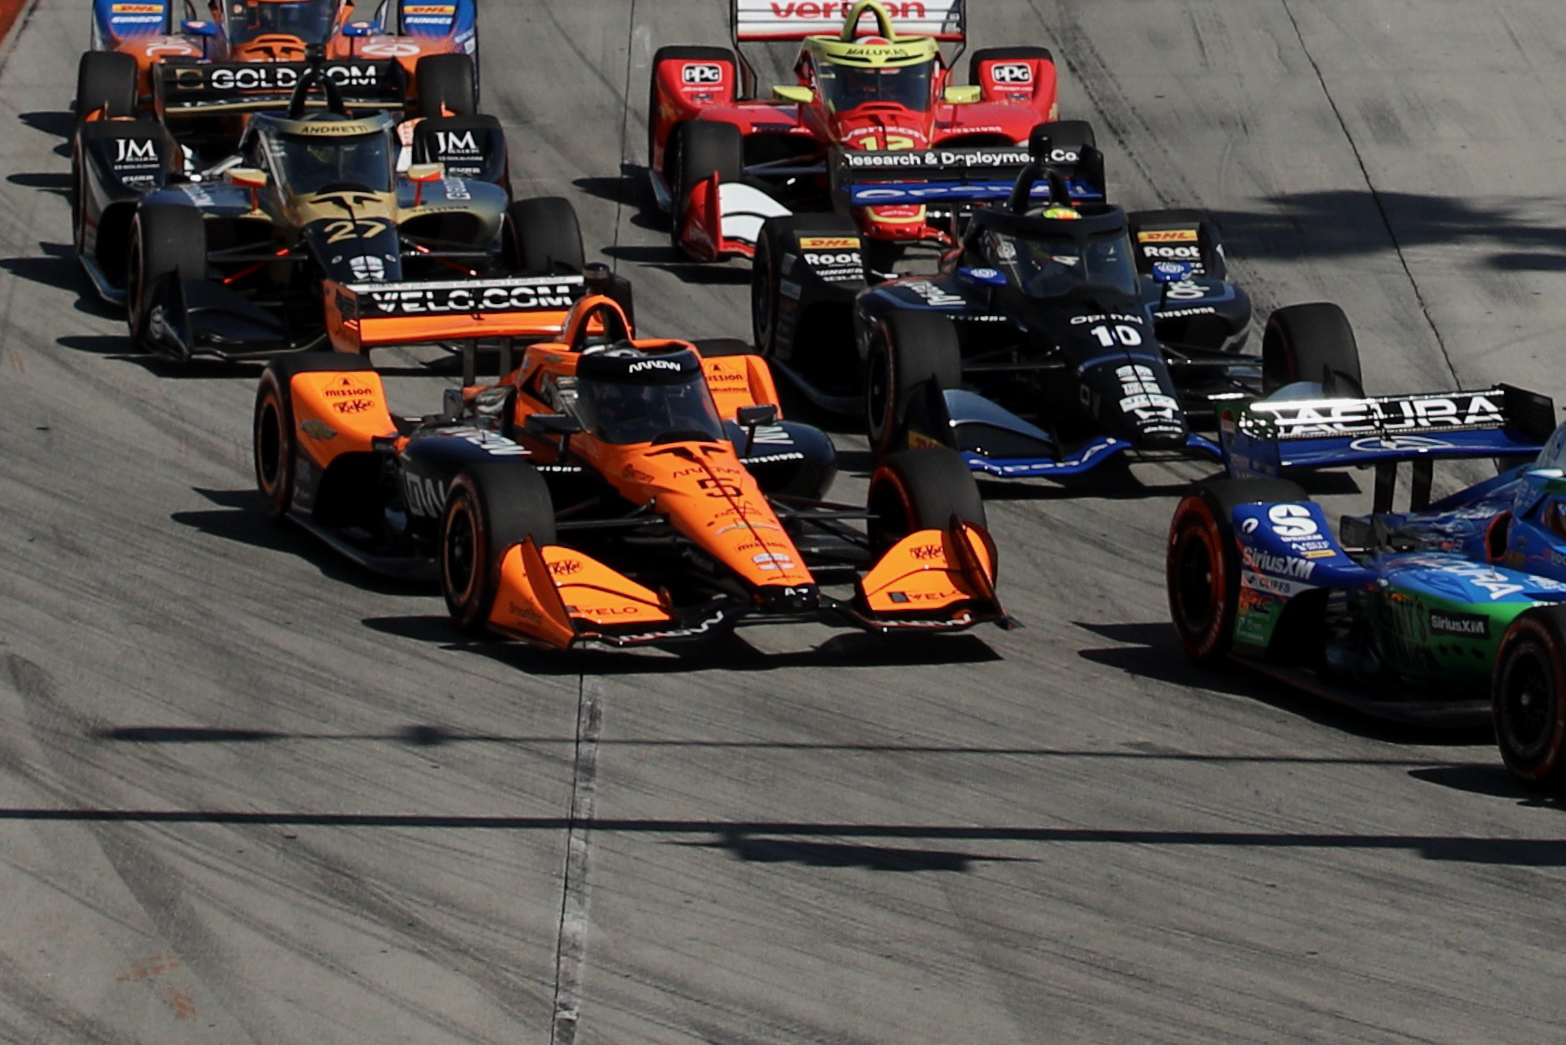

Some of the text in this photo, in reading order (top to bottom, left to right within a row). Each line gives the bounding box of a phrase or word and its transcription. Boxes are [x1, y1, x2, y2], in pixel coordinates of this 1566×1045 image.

[684, 65, 720, 83] PPG
[994, 64, 1030, 83] PPG
[114, 138, 158, 163] JM
[435, 130, 477, 154] JM
[926, 150, 938, 166] &
[323, 219, 387, 245] 27
[804, 253, 862, 266] Root
[1143, 246, 1201, 258] Root
[1090, 325, 1143, 347] 10
[697, 478, 744, 498] 5
[1243, 547, 1316, 580] SiriusXM
[1258, 577, 1291, 593] CLIFFS
[1431, 614, 1486, 634] SiriusXM
